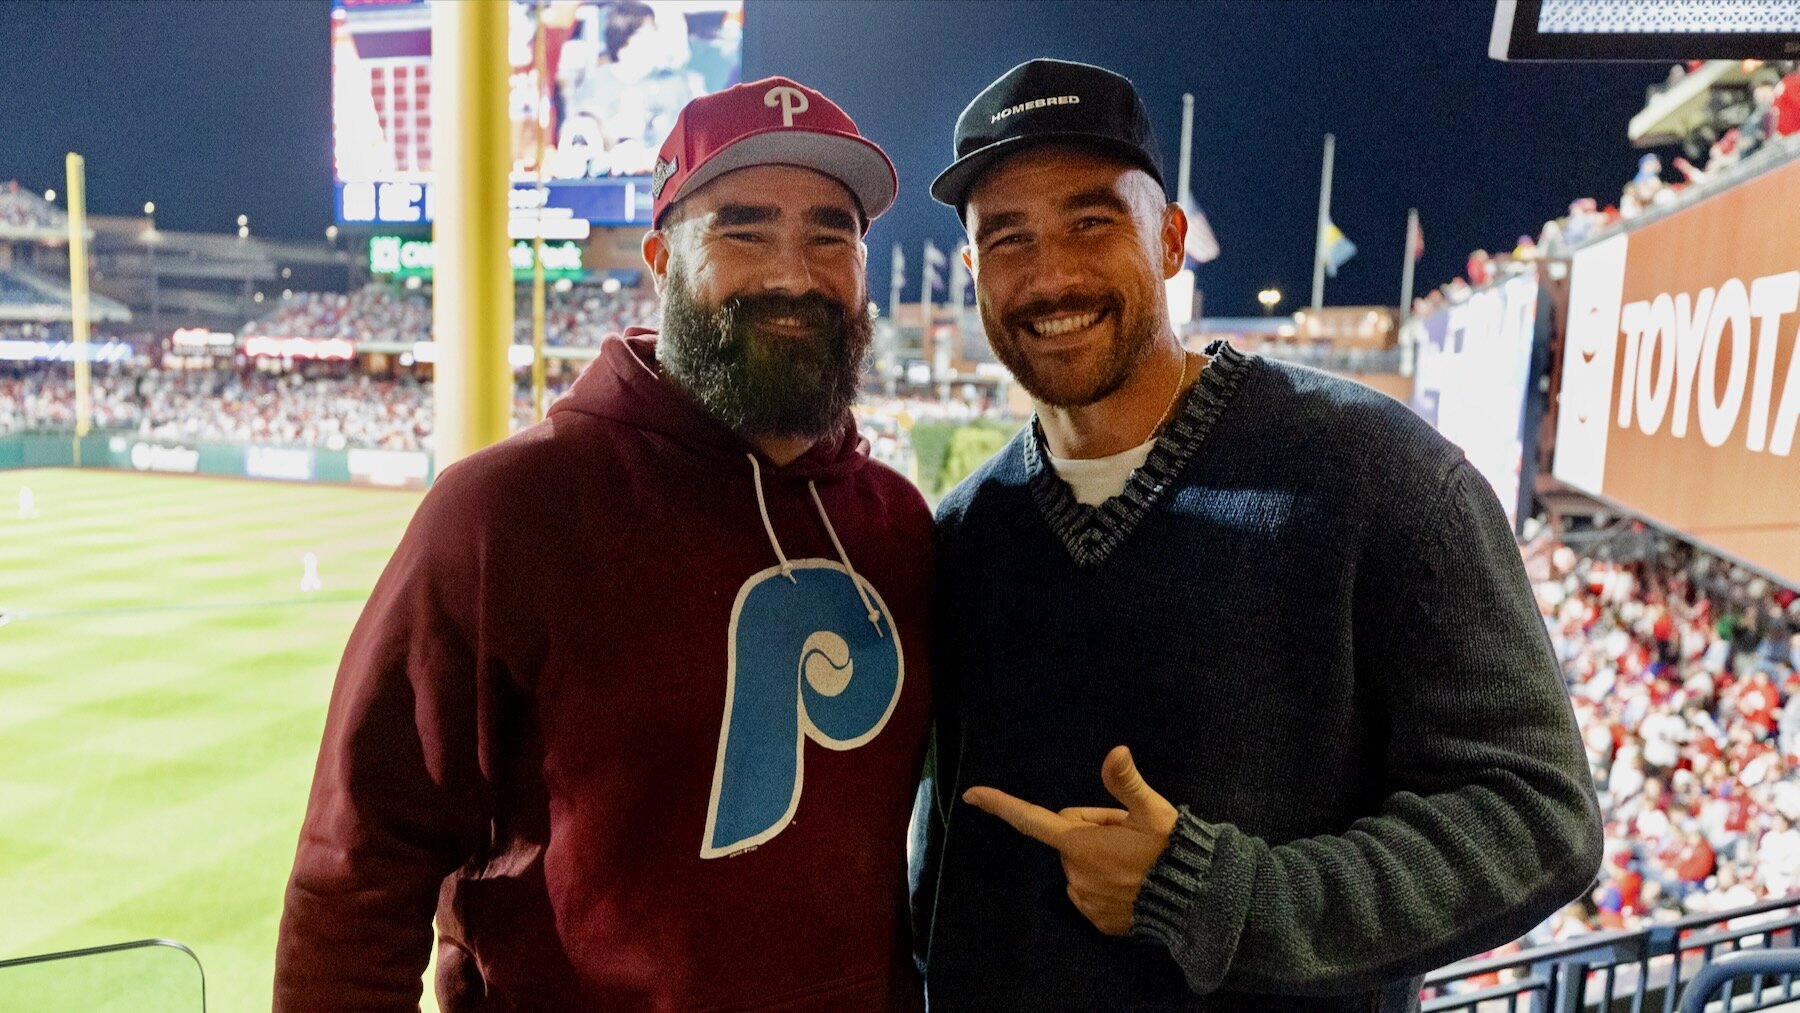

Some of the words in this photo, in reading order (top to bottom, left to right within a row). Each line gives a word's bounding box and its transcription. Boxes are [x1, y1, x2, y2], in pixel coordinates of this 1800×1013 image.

[763, 86, 809, 127] P
[990, 95, 1081, 125] HOMEBRED
[699, 557, 905, 859] P
